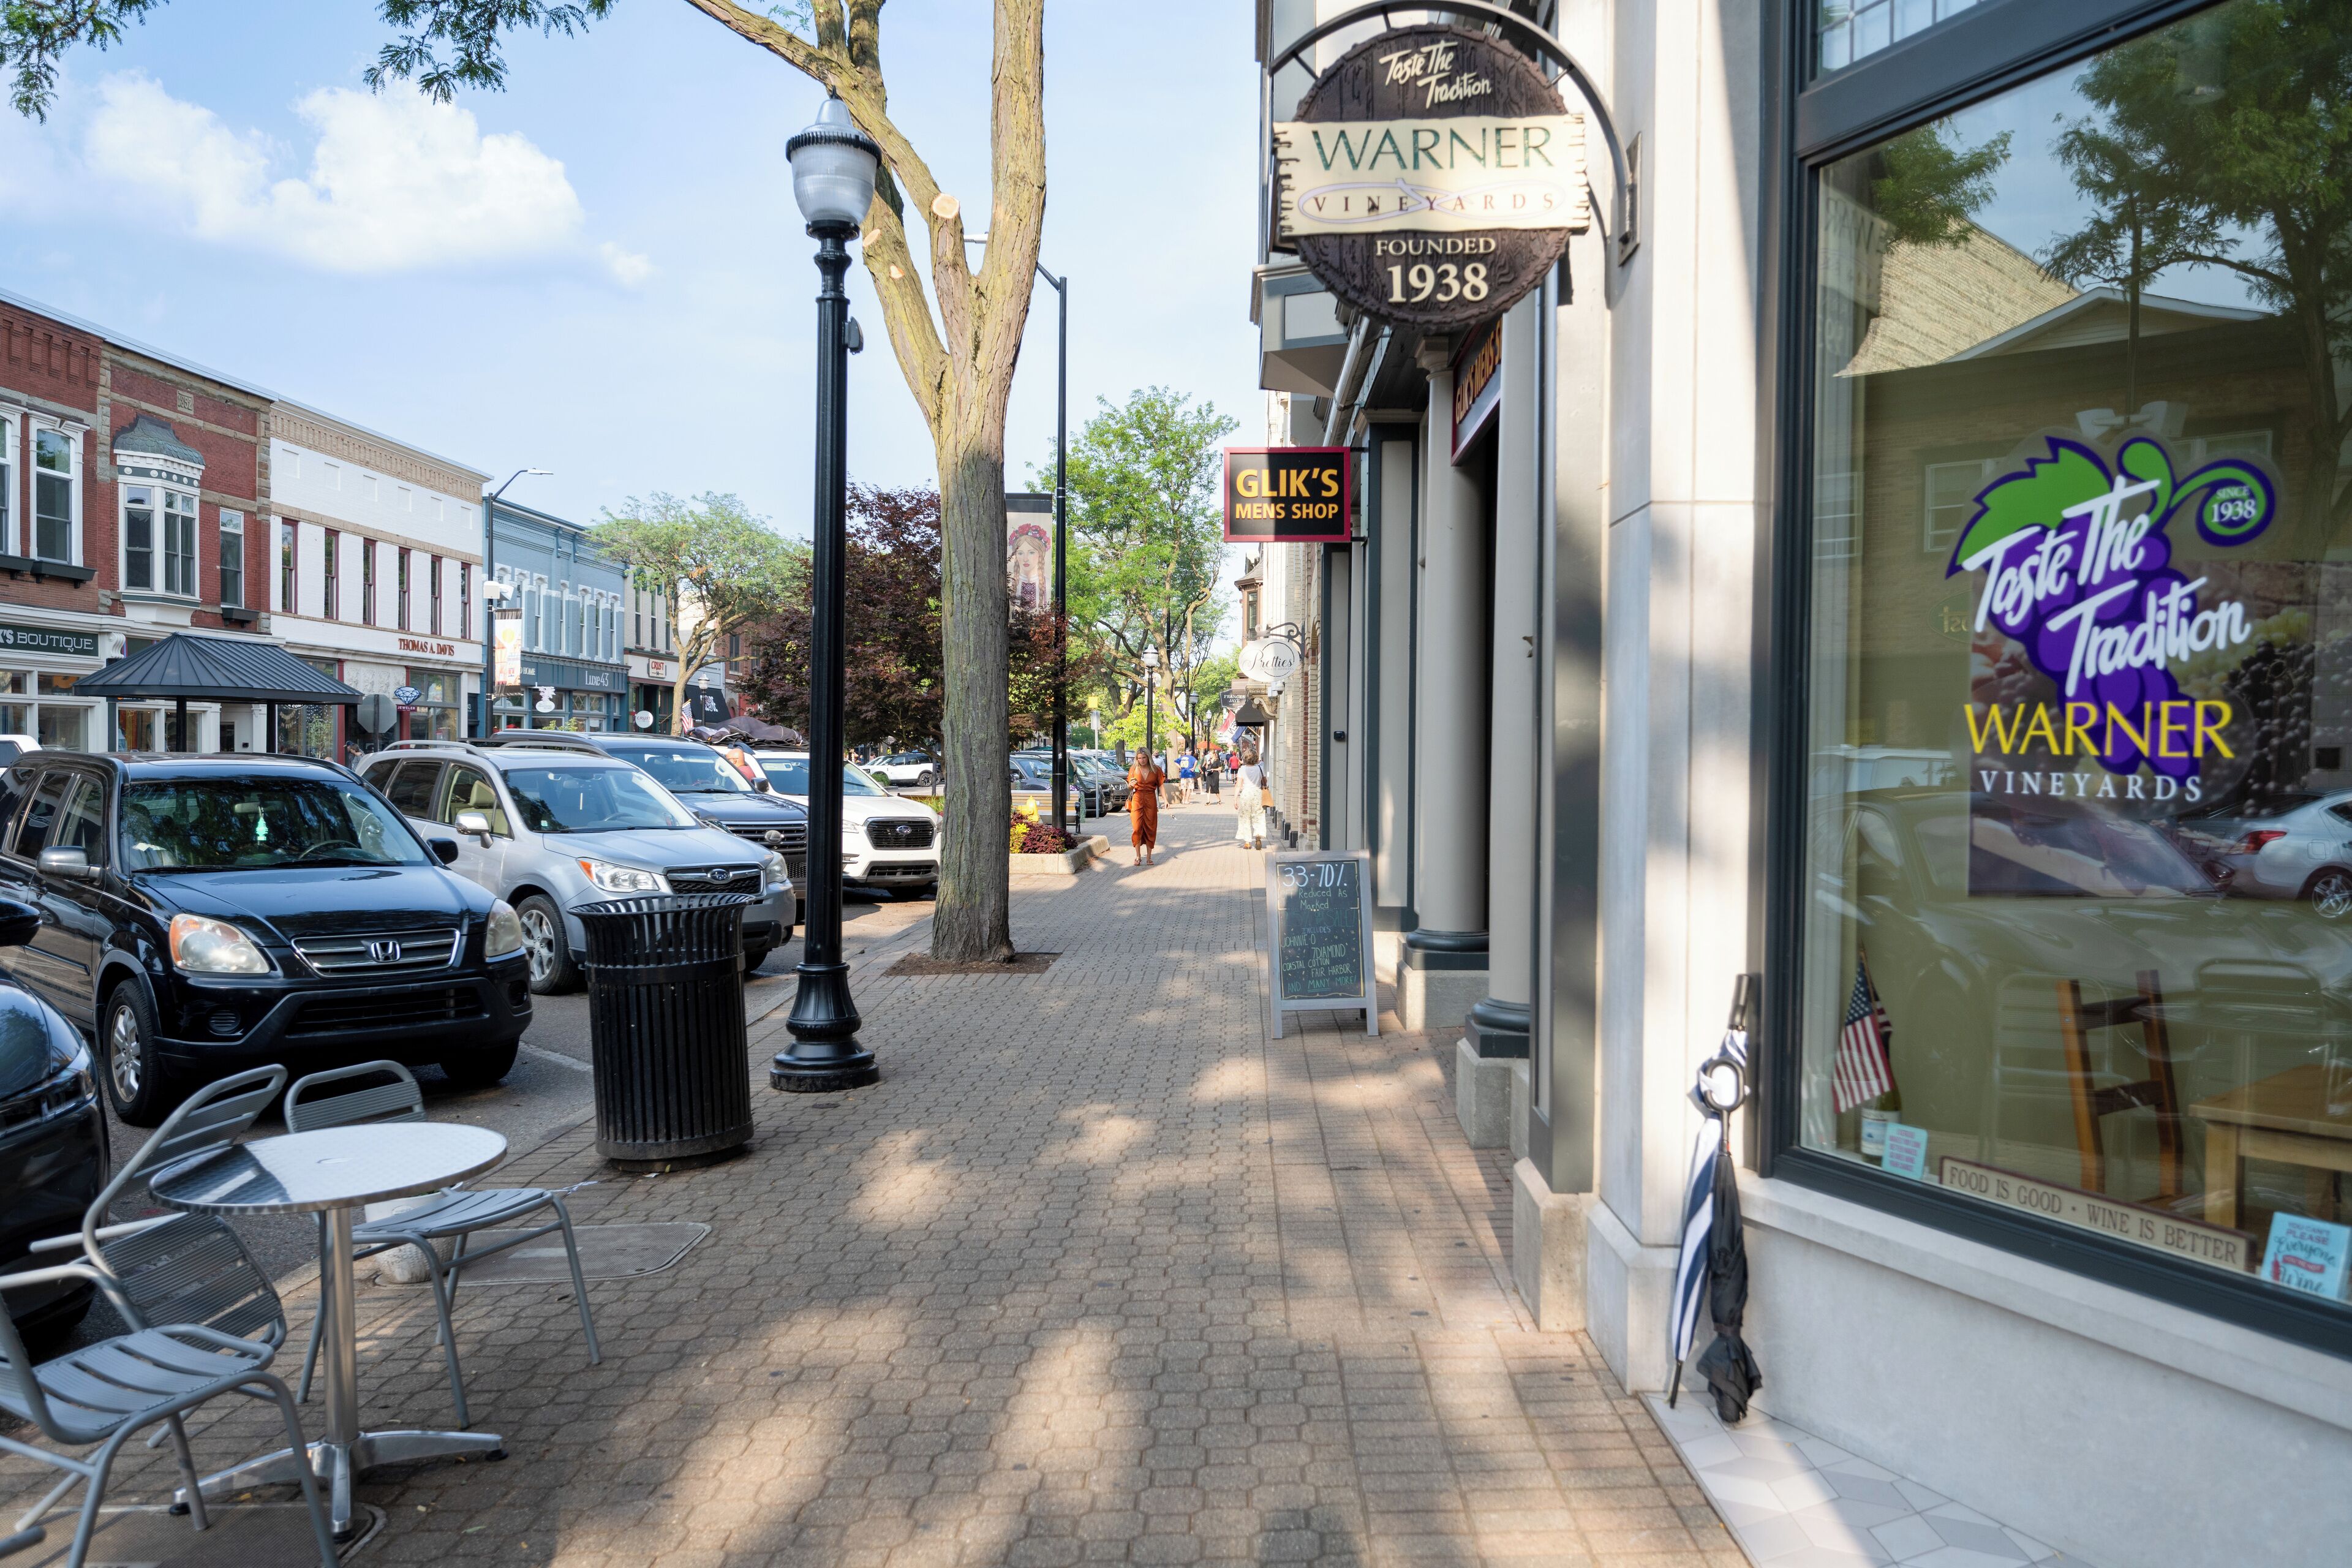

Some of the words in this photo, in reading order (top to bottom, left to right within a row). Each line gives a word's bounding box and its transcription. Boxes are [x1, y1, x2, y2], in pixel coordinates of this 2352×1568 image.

[1379, 49, 1427, 86] Taste
[1420, 40, 1458, 74] The
[1416, 72, 1491, 110] Tradition
[1311, 127, 1554, 171] WARNER
[1313, 193, 1554, 213] VINEYARDS
[1376, 237, 1496, 256] FOUNDED
[1387, 263, 1489, 303] 1938
[1236, 467, 1339, 498] GLIK'S
[2215, 486, 2250, 500] SINCE
[1235, 503, 1286, 520] MENS
[1292, 503, 1339, 519] SHOP
[2211, 500, 2257, 524] 1938
[1962, 526, 2079, 633] Taste
[2062, 475, 2162, 586] The
[17, 631, 94, 652] BOUTIQUE
[398, 638, 428, 653] THOMAS
[429, 643, 435, 654] A.
[437, 643, 454, 656] DAVIS
[2045, 576, 2252, 698] Tradition
[651, 661, 665, 671] CRUST
[1243, 649, 1292, 671] Pretties
[523, 667, 535, 676] HOME
[1964, 699, 2235, 758] WARNER
[1978, 769, 2203, 802] VINEYARDS
[1298, 888, 1332, 899] Reduced
[1301, 925, 1331, 934] INCLUDES
[1281, 934, 1308, 948] JOHNNIE
[1283, 960, 1305, 971] COASTAL
[1308, 958, 1330, 968] COTTON
[1311, 967, 1325, 978] FAIR
[1328, 963, 1352, 975] HARBOR
[1288, 981, 1301, 992] AND
[1308, 978, 1330, 989] MANY
[1949, 1166, 1989, 1194] FOOD
[1995, 1178, 2010, 1200] IS
[2017, 1185, 2062, 1214] GOOD
[2086, 1202, 2132, 1234] WINE
[2138, 1218, 2156, 1241] IS
[2164, 1224, 2237, 1265] BETTER
[2286, 1229, 2329, 1245] PLEASE
